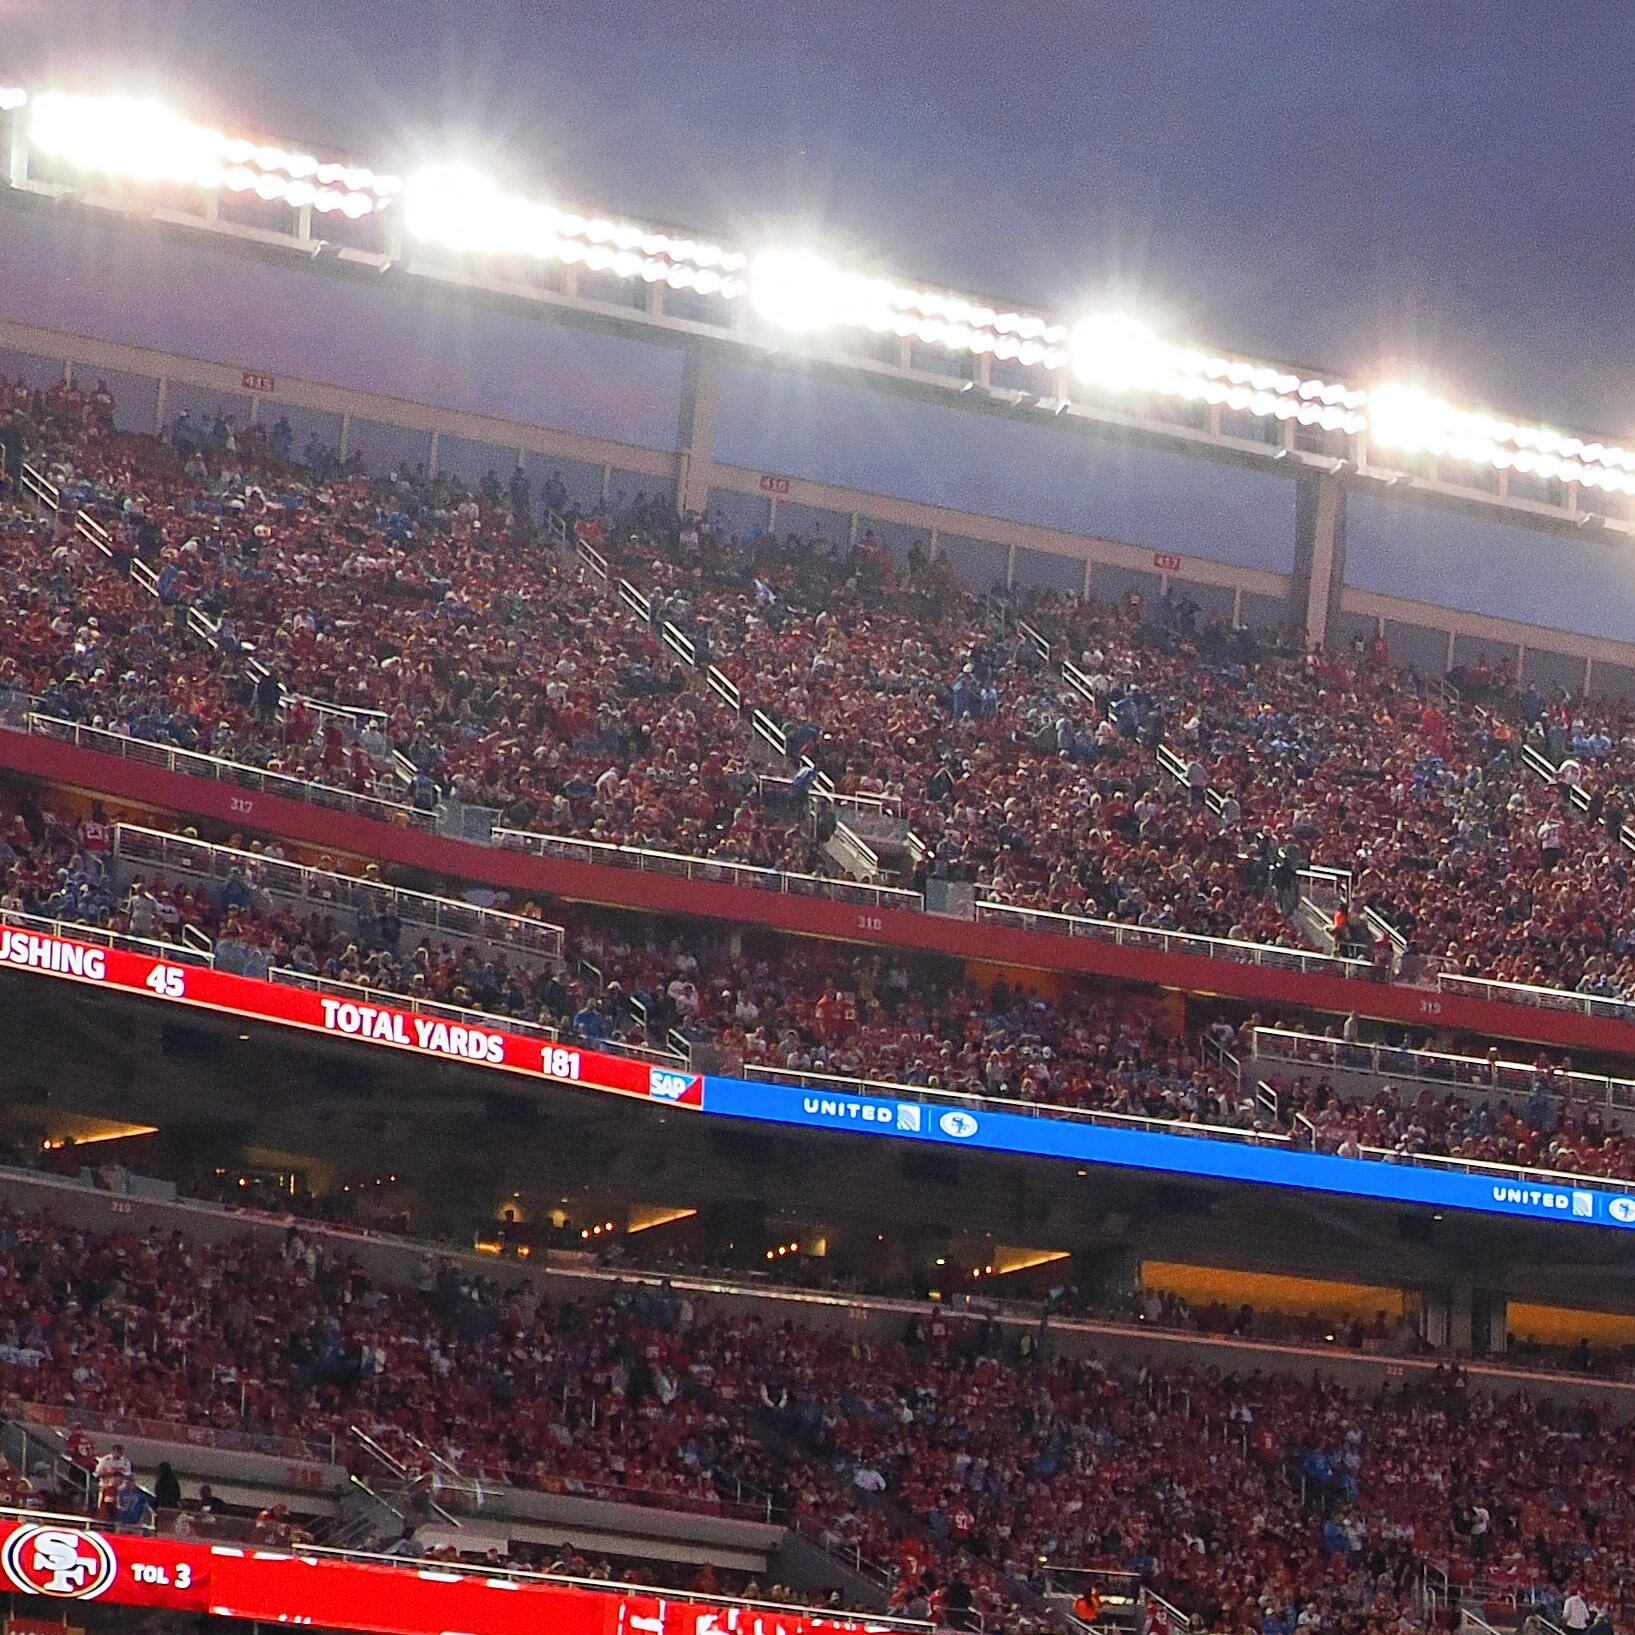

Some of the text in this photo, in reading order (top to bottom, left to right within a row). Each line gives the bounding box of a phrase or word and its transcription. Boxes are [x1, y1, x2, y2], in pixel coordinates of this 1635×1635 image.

[230, 797, 253, 814] 317
[146, 964, 184, 997] 45
[321, 999, 581, 1080] TOTAL YARDS 181
[650, 1071, 688, 1099] SAP
[803, 1097, 893, 1123] UNITED
[1493, 1187, 1569, 1210] UNITED
[131, 1563, 191, 1588] TOL 3
